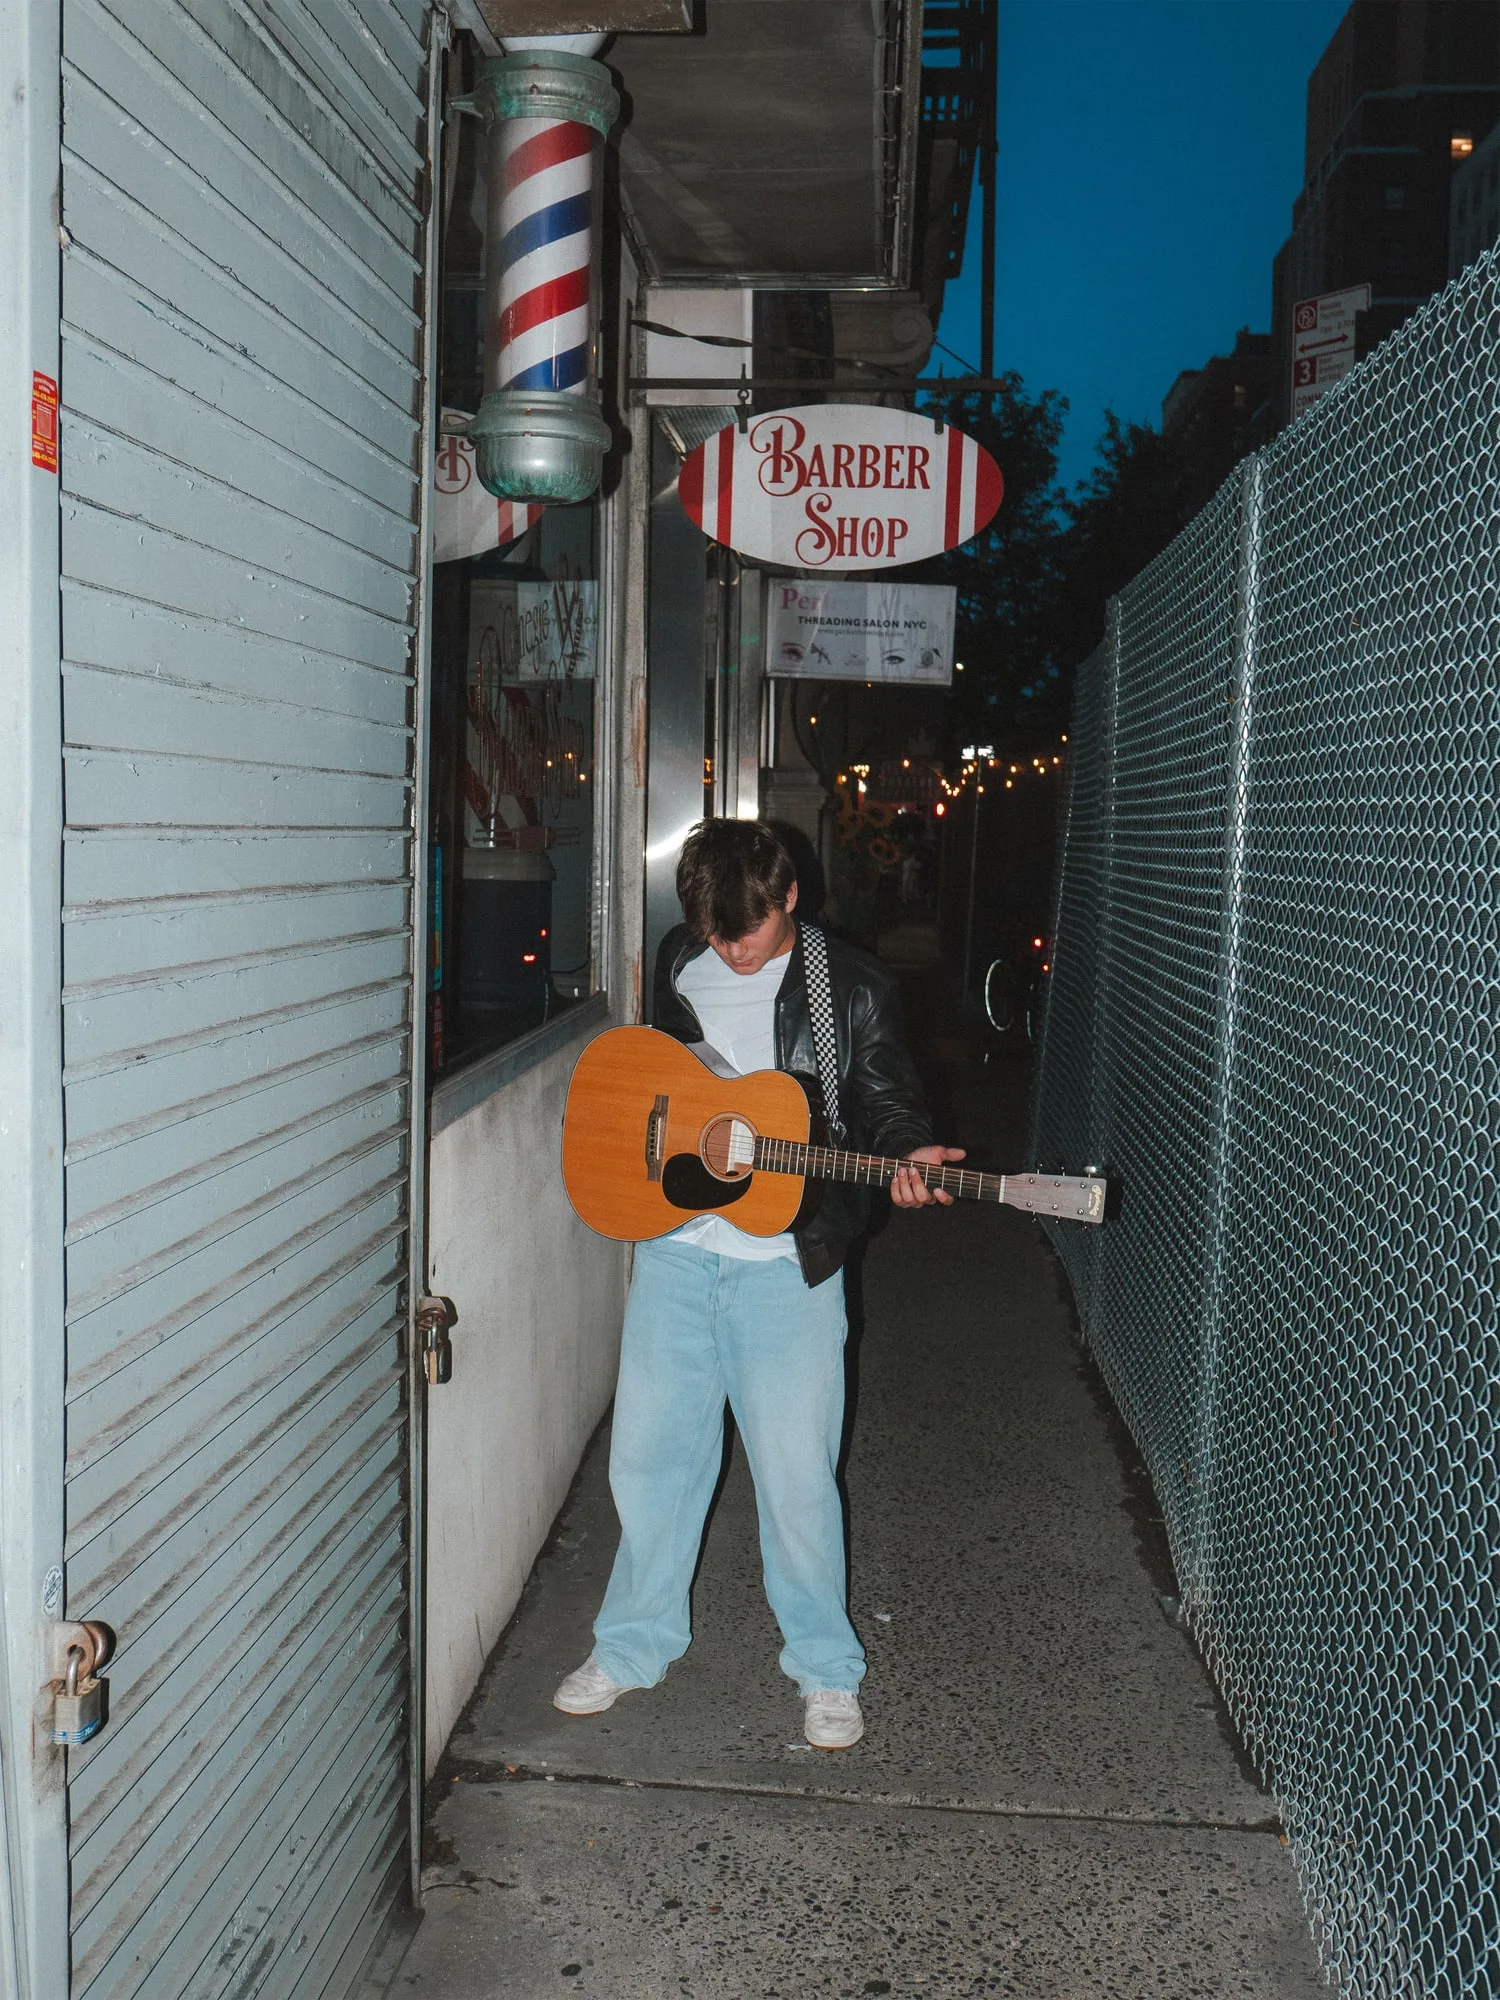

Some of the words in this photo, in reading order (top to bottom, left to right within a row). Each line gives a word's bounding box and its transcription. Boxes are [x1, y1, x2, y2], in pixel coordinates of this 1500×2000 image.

[1299, 360, 1311, 384] 3
[750, 415, 931, 497] BARBER
[795, 492, 909, 566] SHOP
[798, 616, 861, 627] THREADING
[862, 618, 900, 629] SALON
[903, 620, 928, 631] NYC
